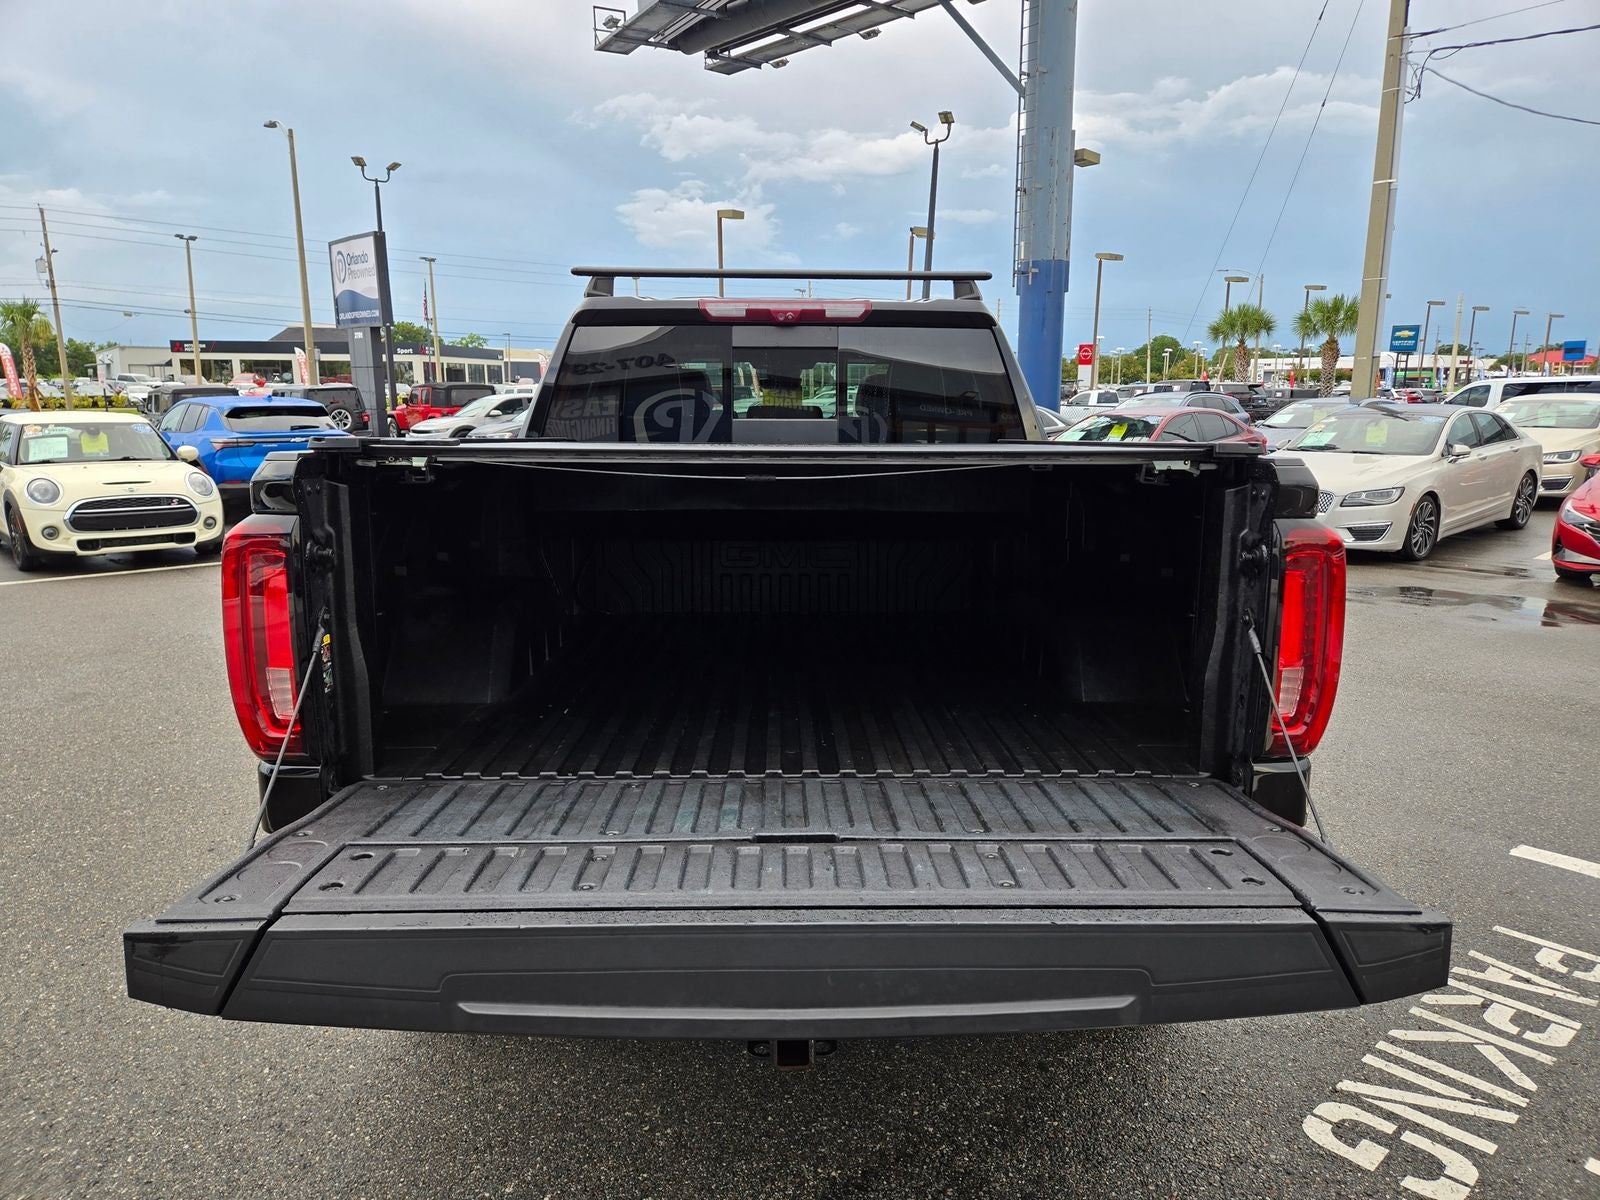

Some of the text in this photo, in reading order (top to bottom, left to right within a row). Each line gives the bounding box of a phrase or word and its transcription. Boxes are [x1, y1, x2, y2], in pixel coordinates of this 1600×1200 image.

[346, 251, 369, 265] Orlando
[347, 265, 376, 280] Preowned
[396, 347, 414, 355] Sport
[722, 542, 854, 569] GMC
[1302, 925, 1600, 1200] PARKING
